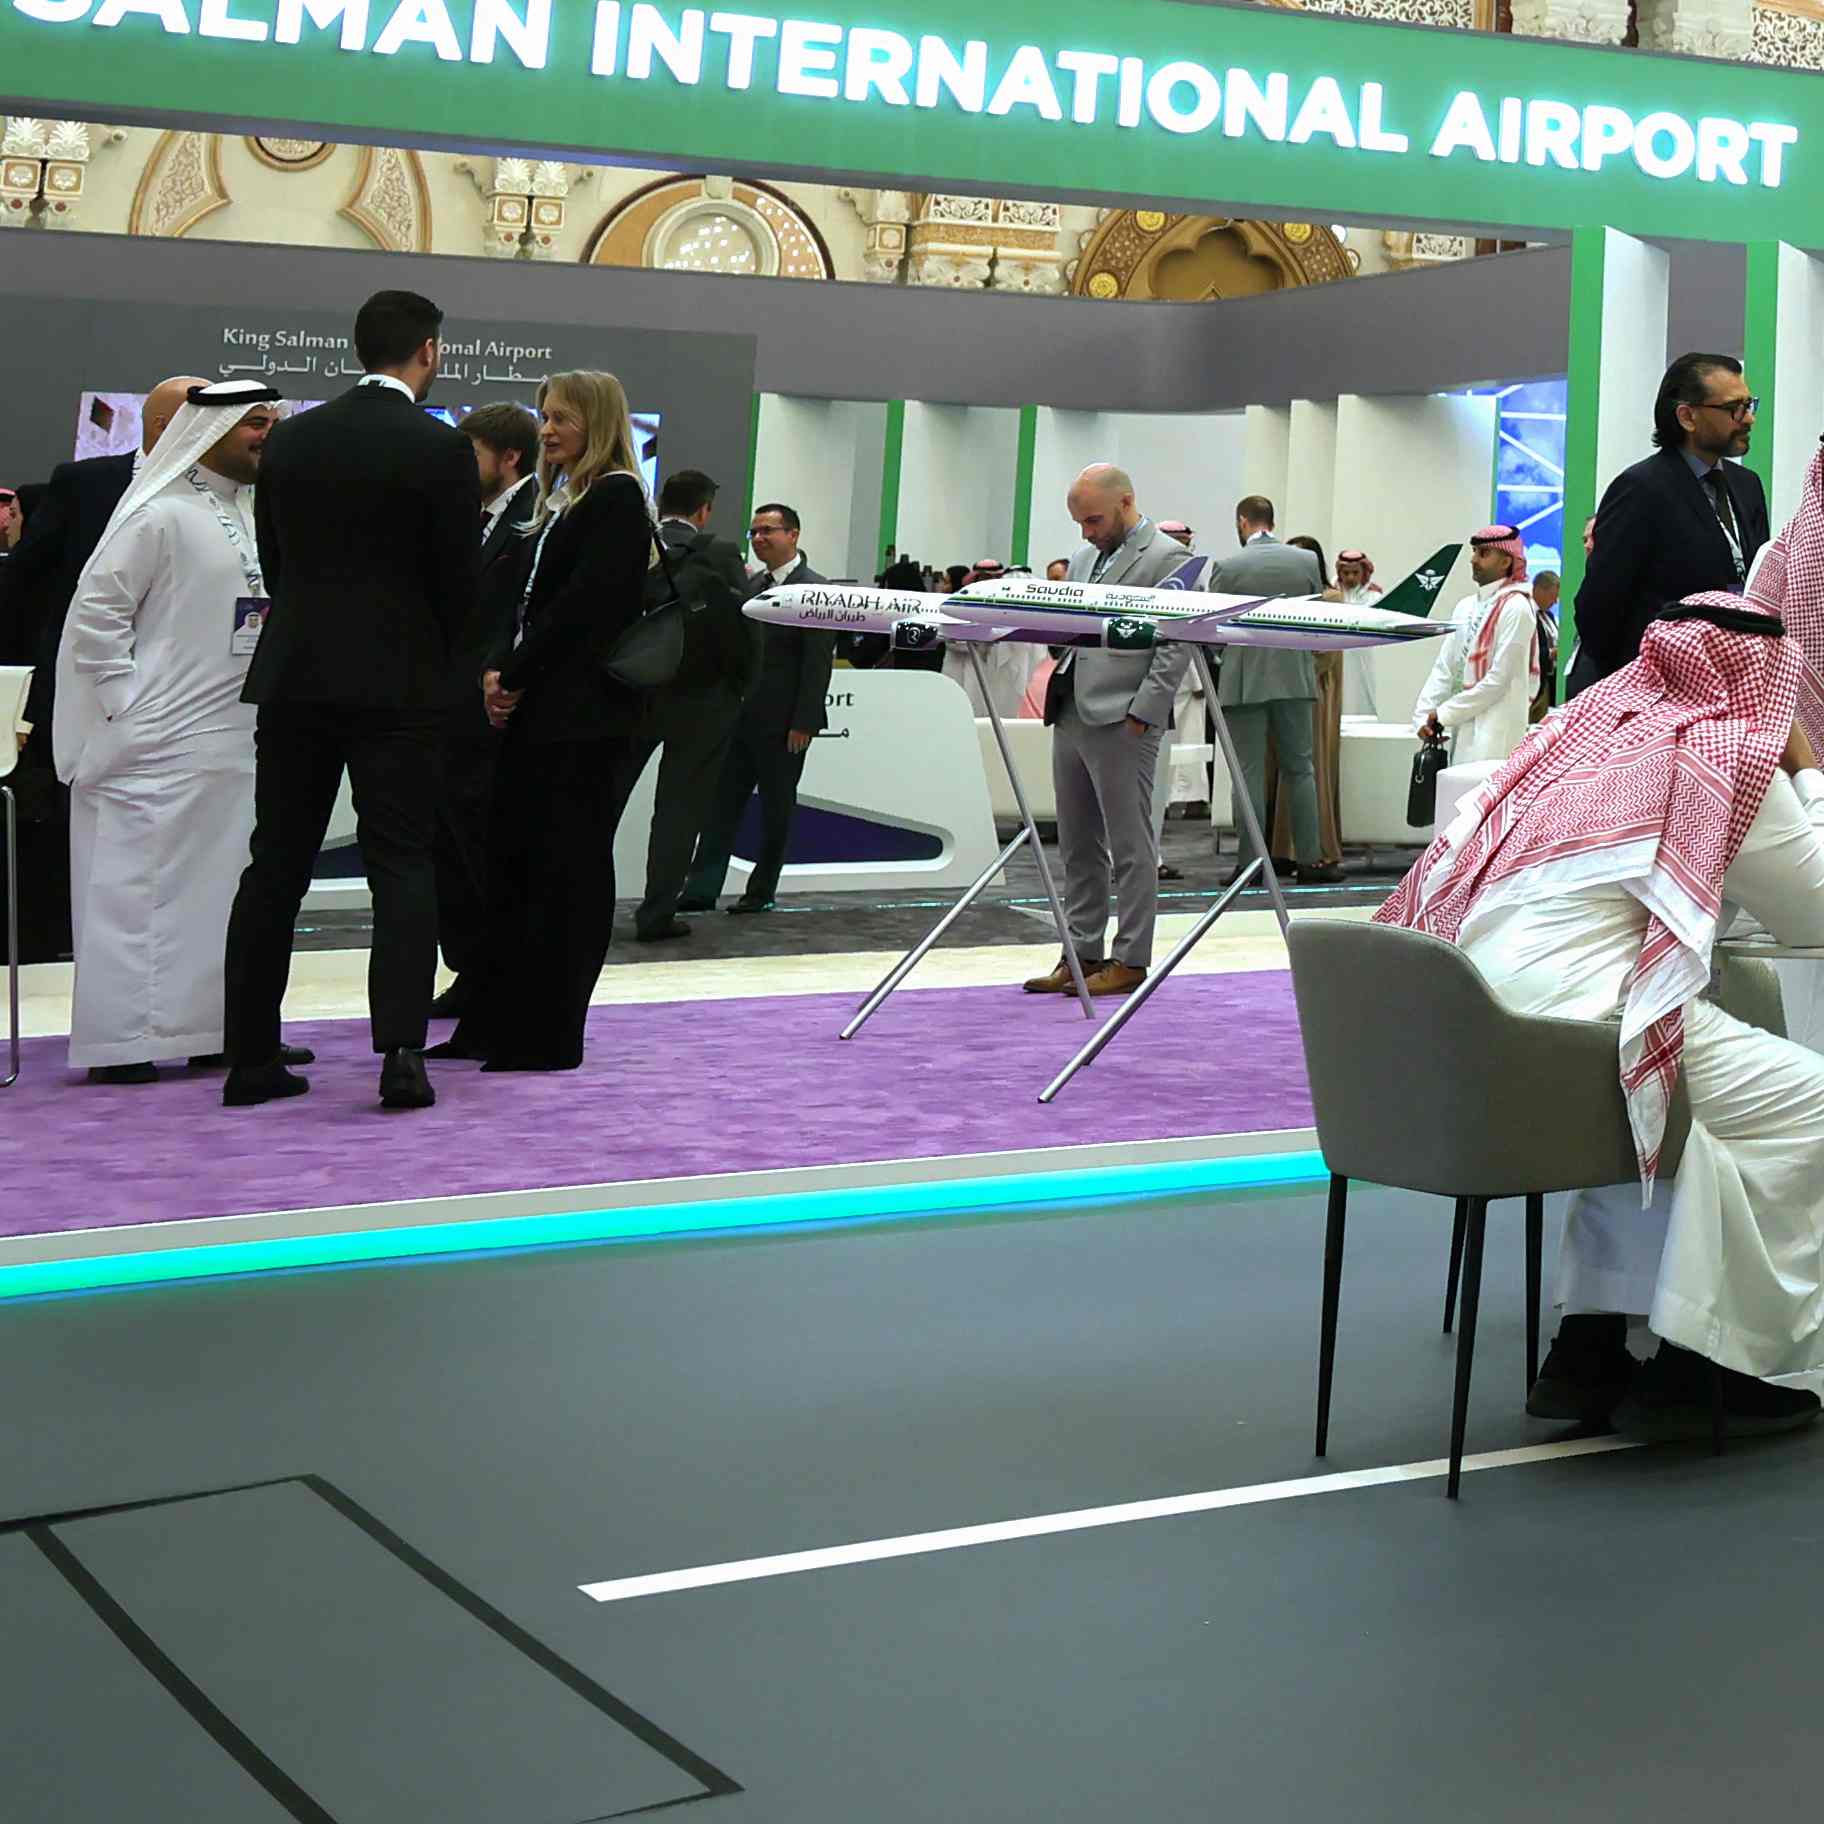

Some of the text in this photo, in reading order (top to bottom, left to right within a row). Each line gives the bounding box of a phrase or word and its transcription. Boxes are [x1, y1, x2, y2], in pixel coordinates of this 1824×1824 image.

[591, 0, 1409, 154] INTERNATIONAL
[1432, 90, 1799, 188] AIRPORT
[223, 328, 270, 351] King
[274, 330, 348, 349] Salman
[484, 341, 553, 363] Airport
[219, 354, 317, 377] الدولي
[471, 364, 548, 386] مطار
[800, 589, 881, 610] RIYADH
[1025, 583, 1085, 597] Saudia
